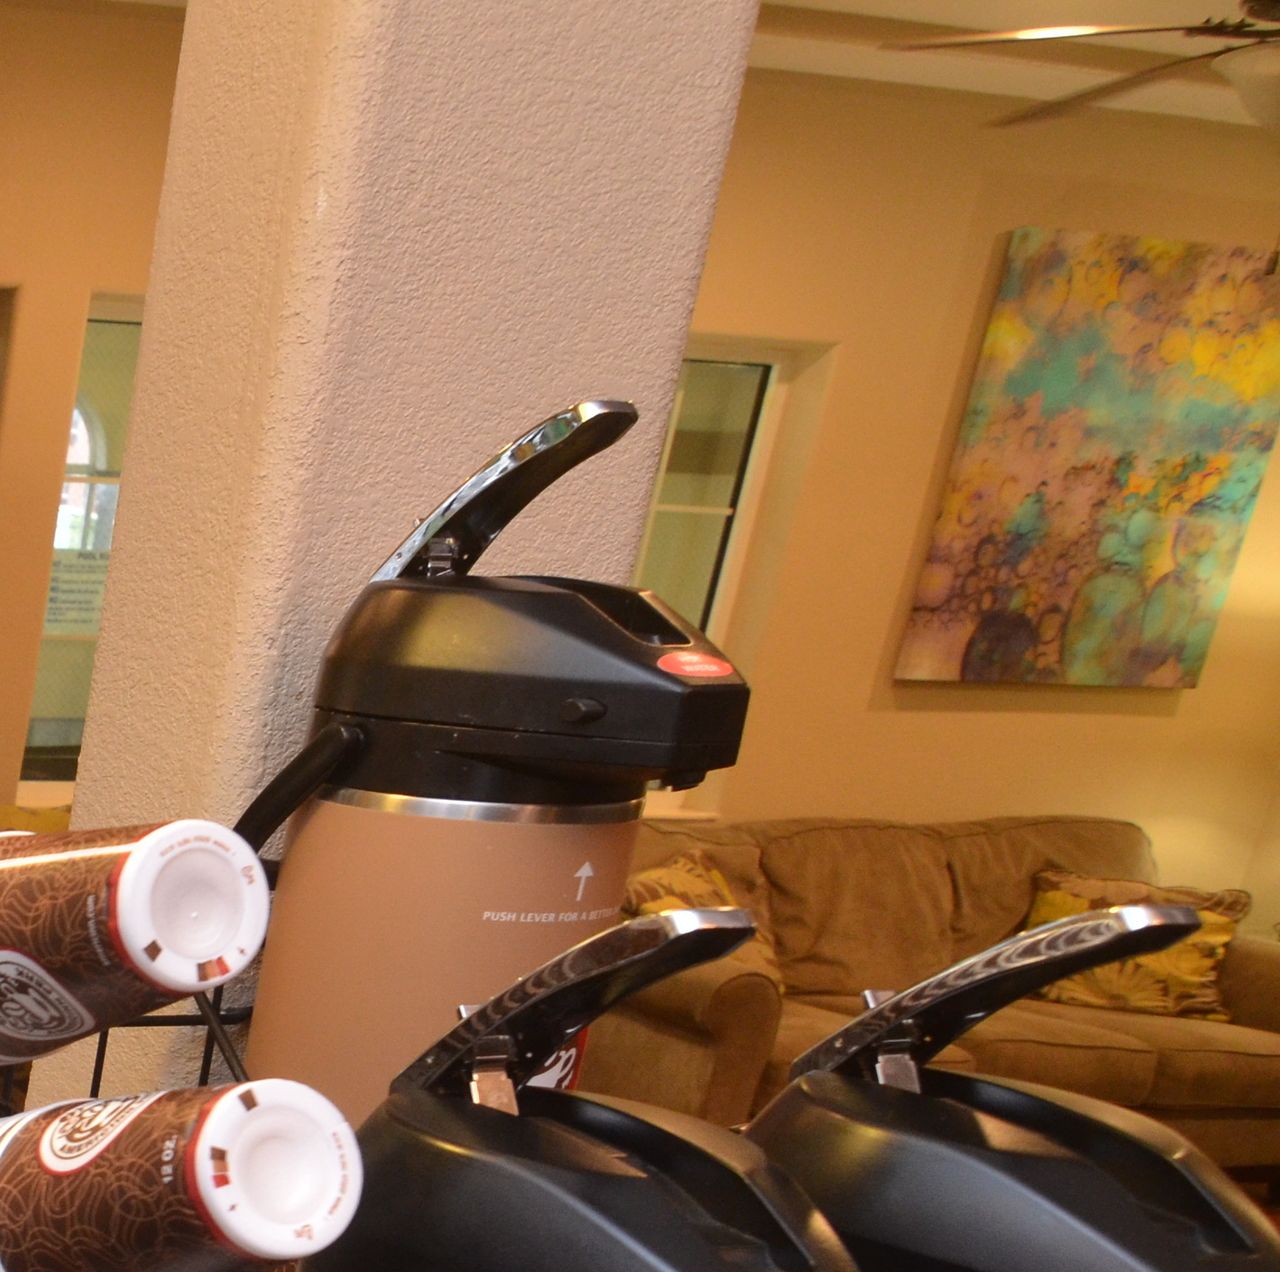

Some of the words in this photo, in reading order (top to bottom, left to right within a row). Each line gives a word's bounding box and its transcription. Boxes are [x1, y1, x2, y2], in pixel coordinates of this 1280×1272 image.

[483, 911, 517, 922] PUSH
[520, 912, 555, 922] LEVER
[558, 912, 577, 922] FOR
